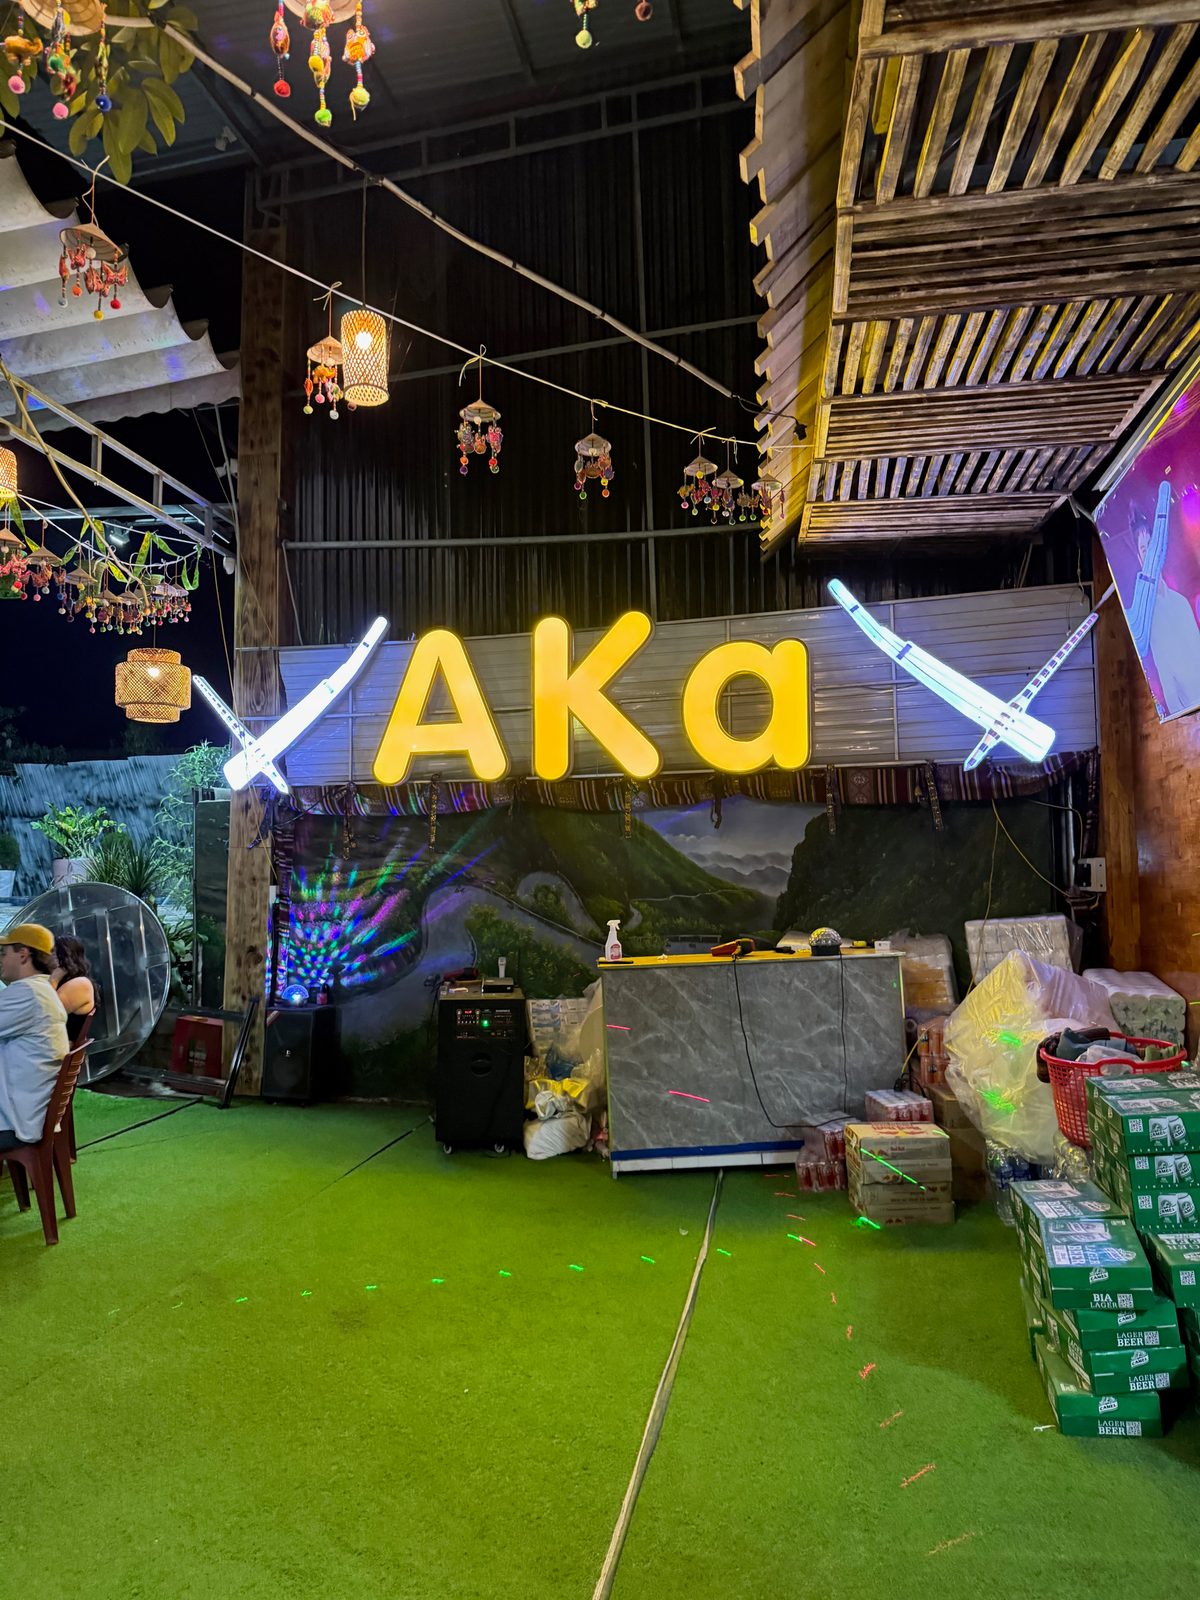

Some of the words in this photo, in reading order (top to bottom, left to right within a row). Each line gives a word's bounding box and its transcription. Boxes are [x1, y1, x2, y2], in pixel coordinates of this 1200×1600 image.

[372, 611, 812, 785] AKa
[1090, 1273, 1108, 1281] CAMEL
[1093, 1293, 1112, 1302] BIA
[1090, 1301, 1118, 1309] LAGER
[1118, 1314, 1135, 1323] CAMEL
[1116, 1331, 1144, 1339] LAGER
[1117, 1337, 1144, 1347] BEER
[1131, 1357, 1148, 1366] CAMEL
[1128, 1374, 1155, 1383] LAGER
[1130, 1380, 1156, 1391] BEER
[1099, 1403, 1117, 1411] CAMEL
[1098, 1419, 1126, 1427] LAGER
[1098, 1426, 1127, 1436] BEER
